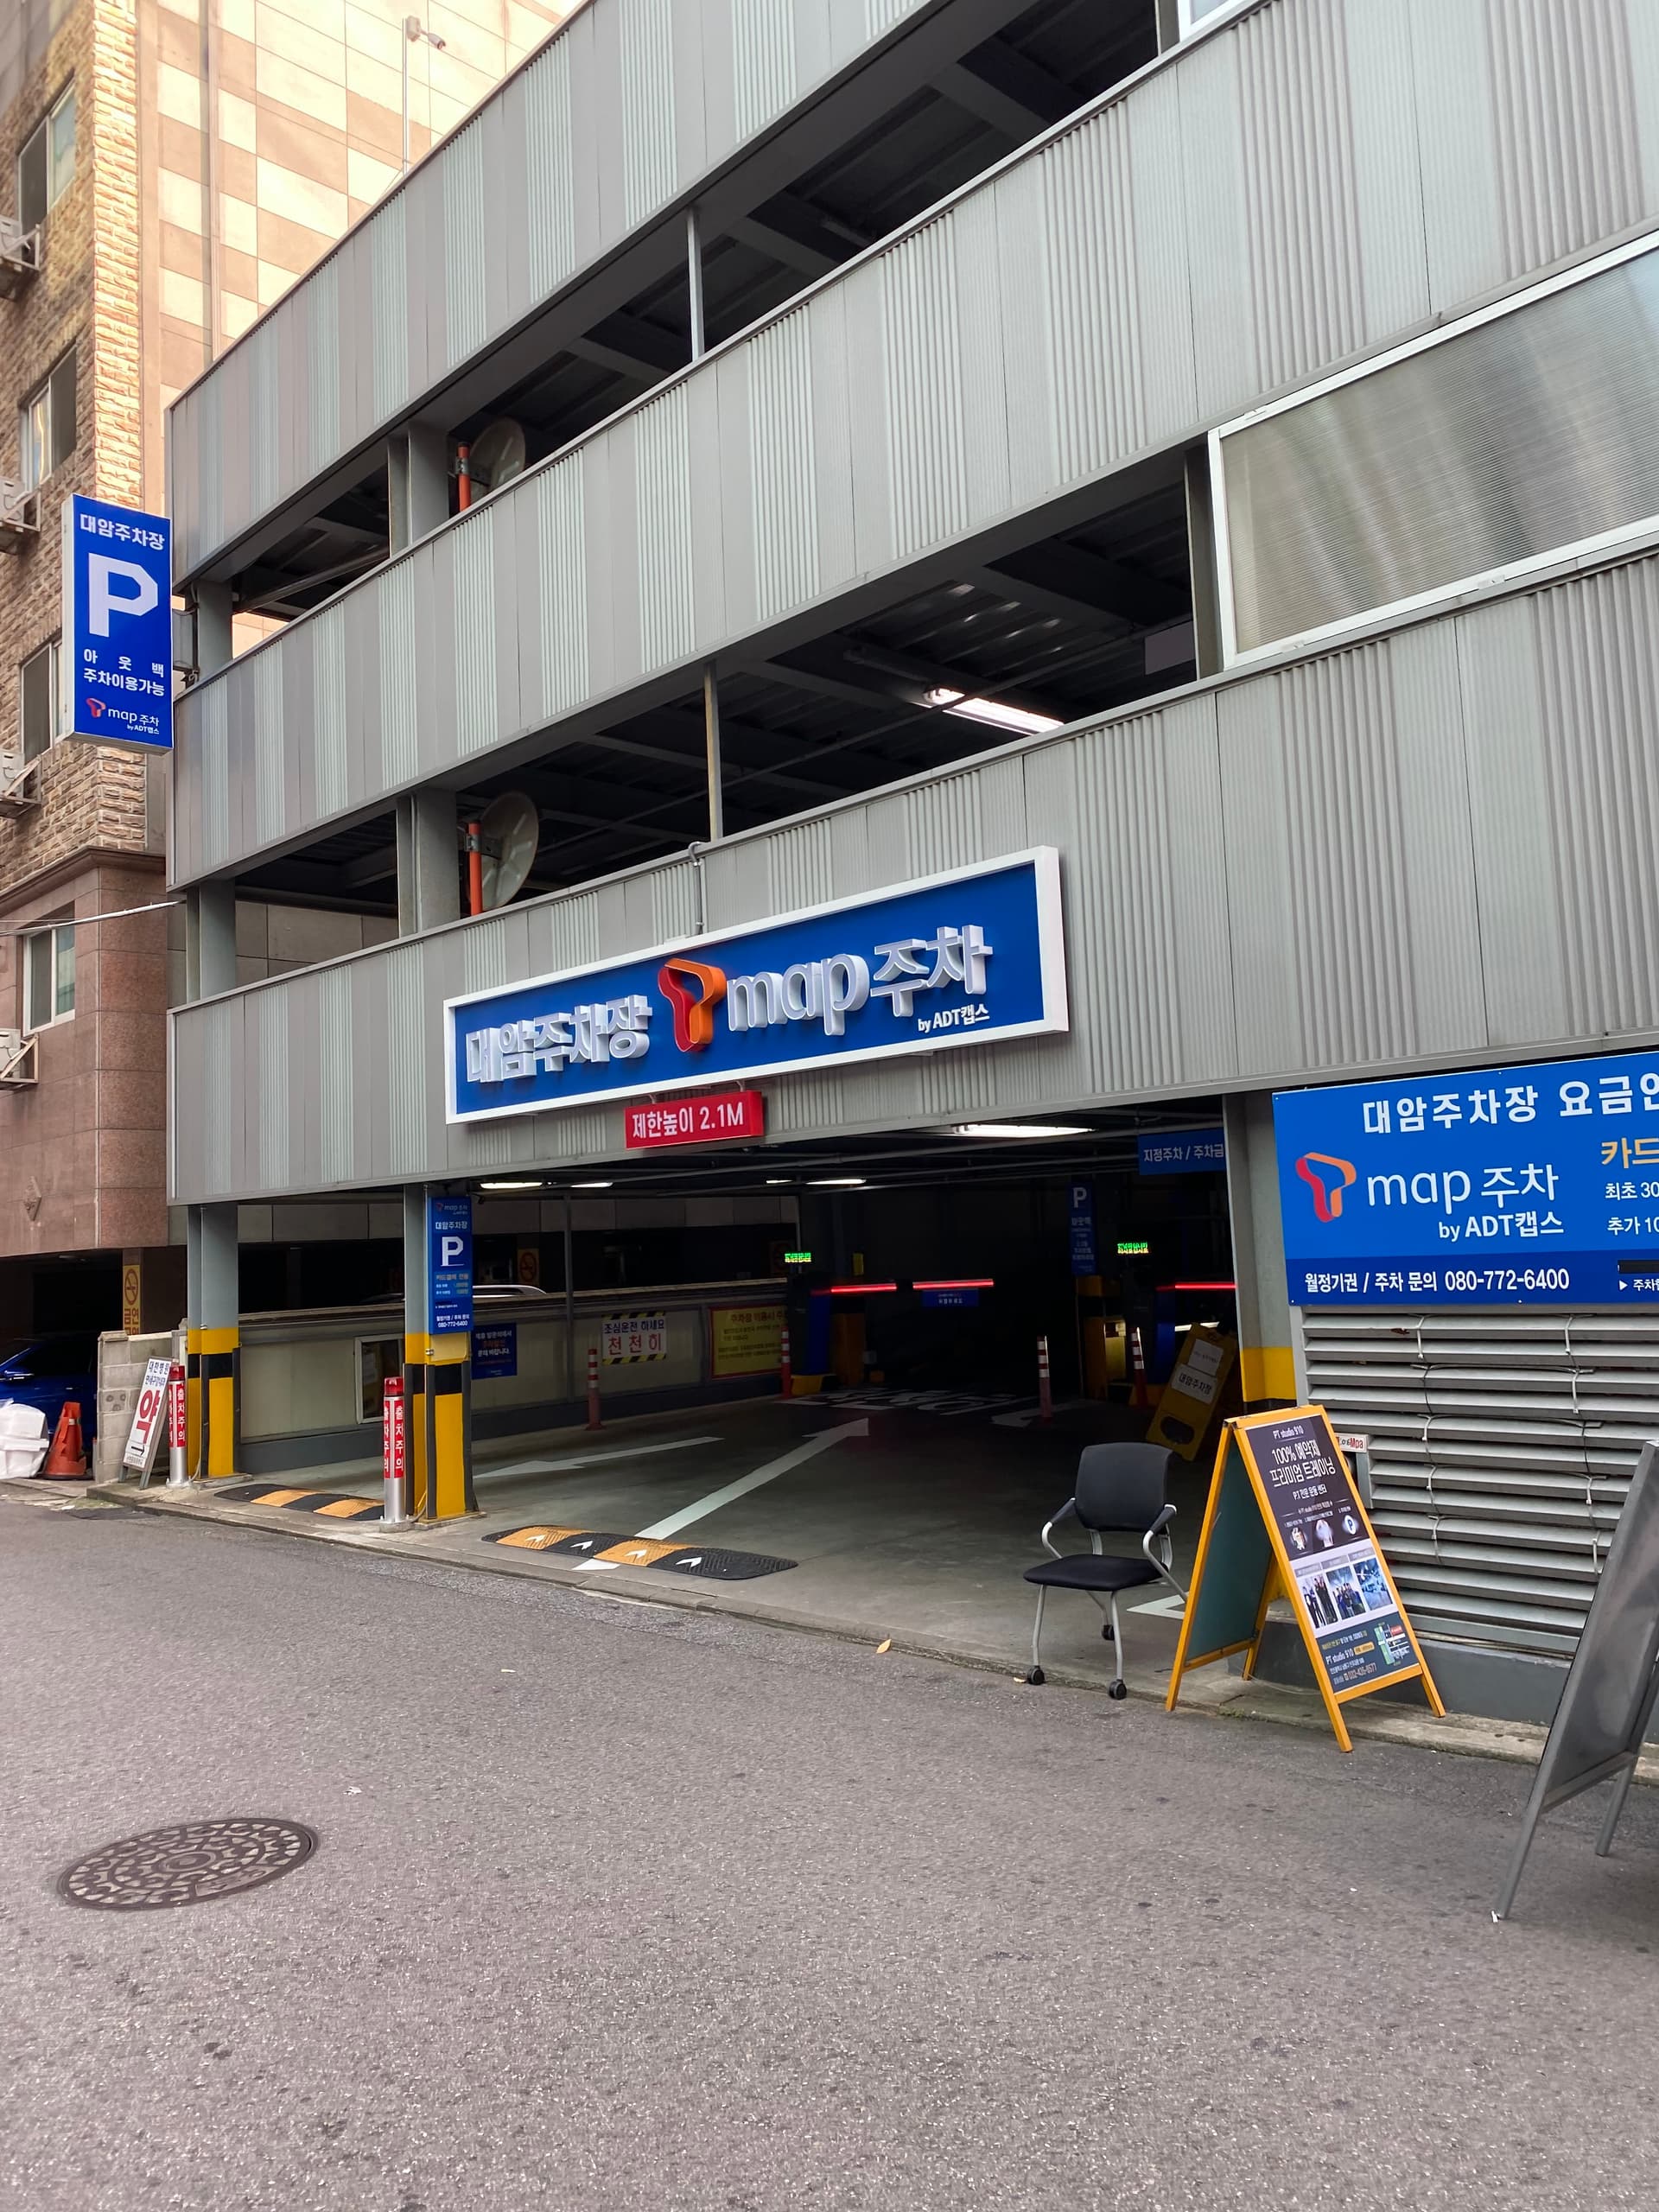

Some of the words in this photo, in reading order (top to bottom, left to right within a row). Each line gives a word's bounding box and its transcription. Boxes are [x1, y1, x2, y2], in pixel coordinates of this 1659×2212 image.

[80, 514, 165, 550] 대암주차장
[88, 552, 159, 638] P
[84, 668, 165, 696] 주차이용가능
[135, 724, 159, 734] ADT캡스
[140, 714, 159, 727] 주차
[467, 995, 652, 1083] 대암주차장
[870, 925, 994, 1017] 주차
[918, 1018, 931, 1033] by
[932, 1004, 990, 1029] ADT캡스
[632, 1108, 694, 1139] 제한높이
[699, 1102, 744, 1131] 2.1M
[1363, 1085, 1539, 1134] 대암주차장
[1143, 1147, 1183, 1162] 지정주차
[1072, 1186, 1087, 1208] P
[1481, 1163, 1559, 1209] 주차
[1605, 1181, 1638, 1200] 최초
[1439, 1222, 1460, 1242] by
[1465, 1211, 1564, 1237] ADT캡스
[1607, 1217, 1641, 1236] 추가
[442, 1236, 464, 1266] P
[1305, 1273, 1357, 1293] 월정기권
[1363, 1272, 1370, 1293] /
[1375, 1272, 1403, 1292] 주차
[1408, 1271, 1437, 1292] 문의
[1445, 1268, 1570, 1291] 080-772-6400
[124, 1308, 138, 1325] 금연
[604, 1320, 637, 1334] 조심운전
[641, 1319, 664, 1332] 하세요
[137, 1389, 161, 1444] 약
[1273, 1430, 1281, 1440] PT
[1272, 1445, 1296, 1465] 100%
[1294, 1440, 1321, 1459] 예약제
[1269, 1464, 1305, 1487] 프리미엄
[1302, 1457, 1336, 1479] 트레이닝
